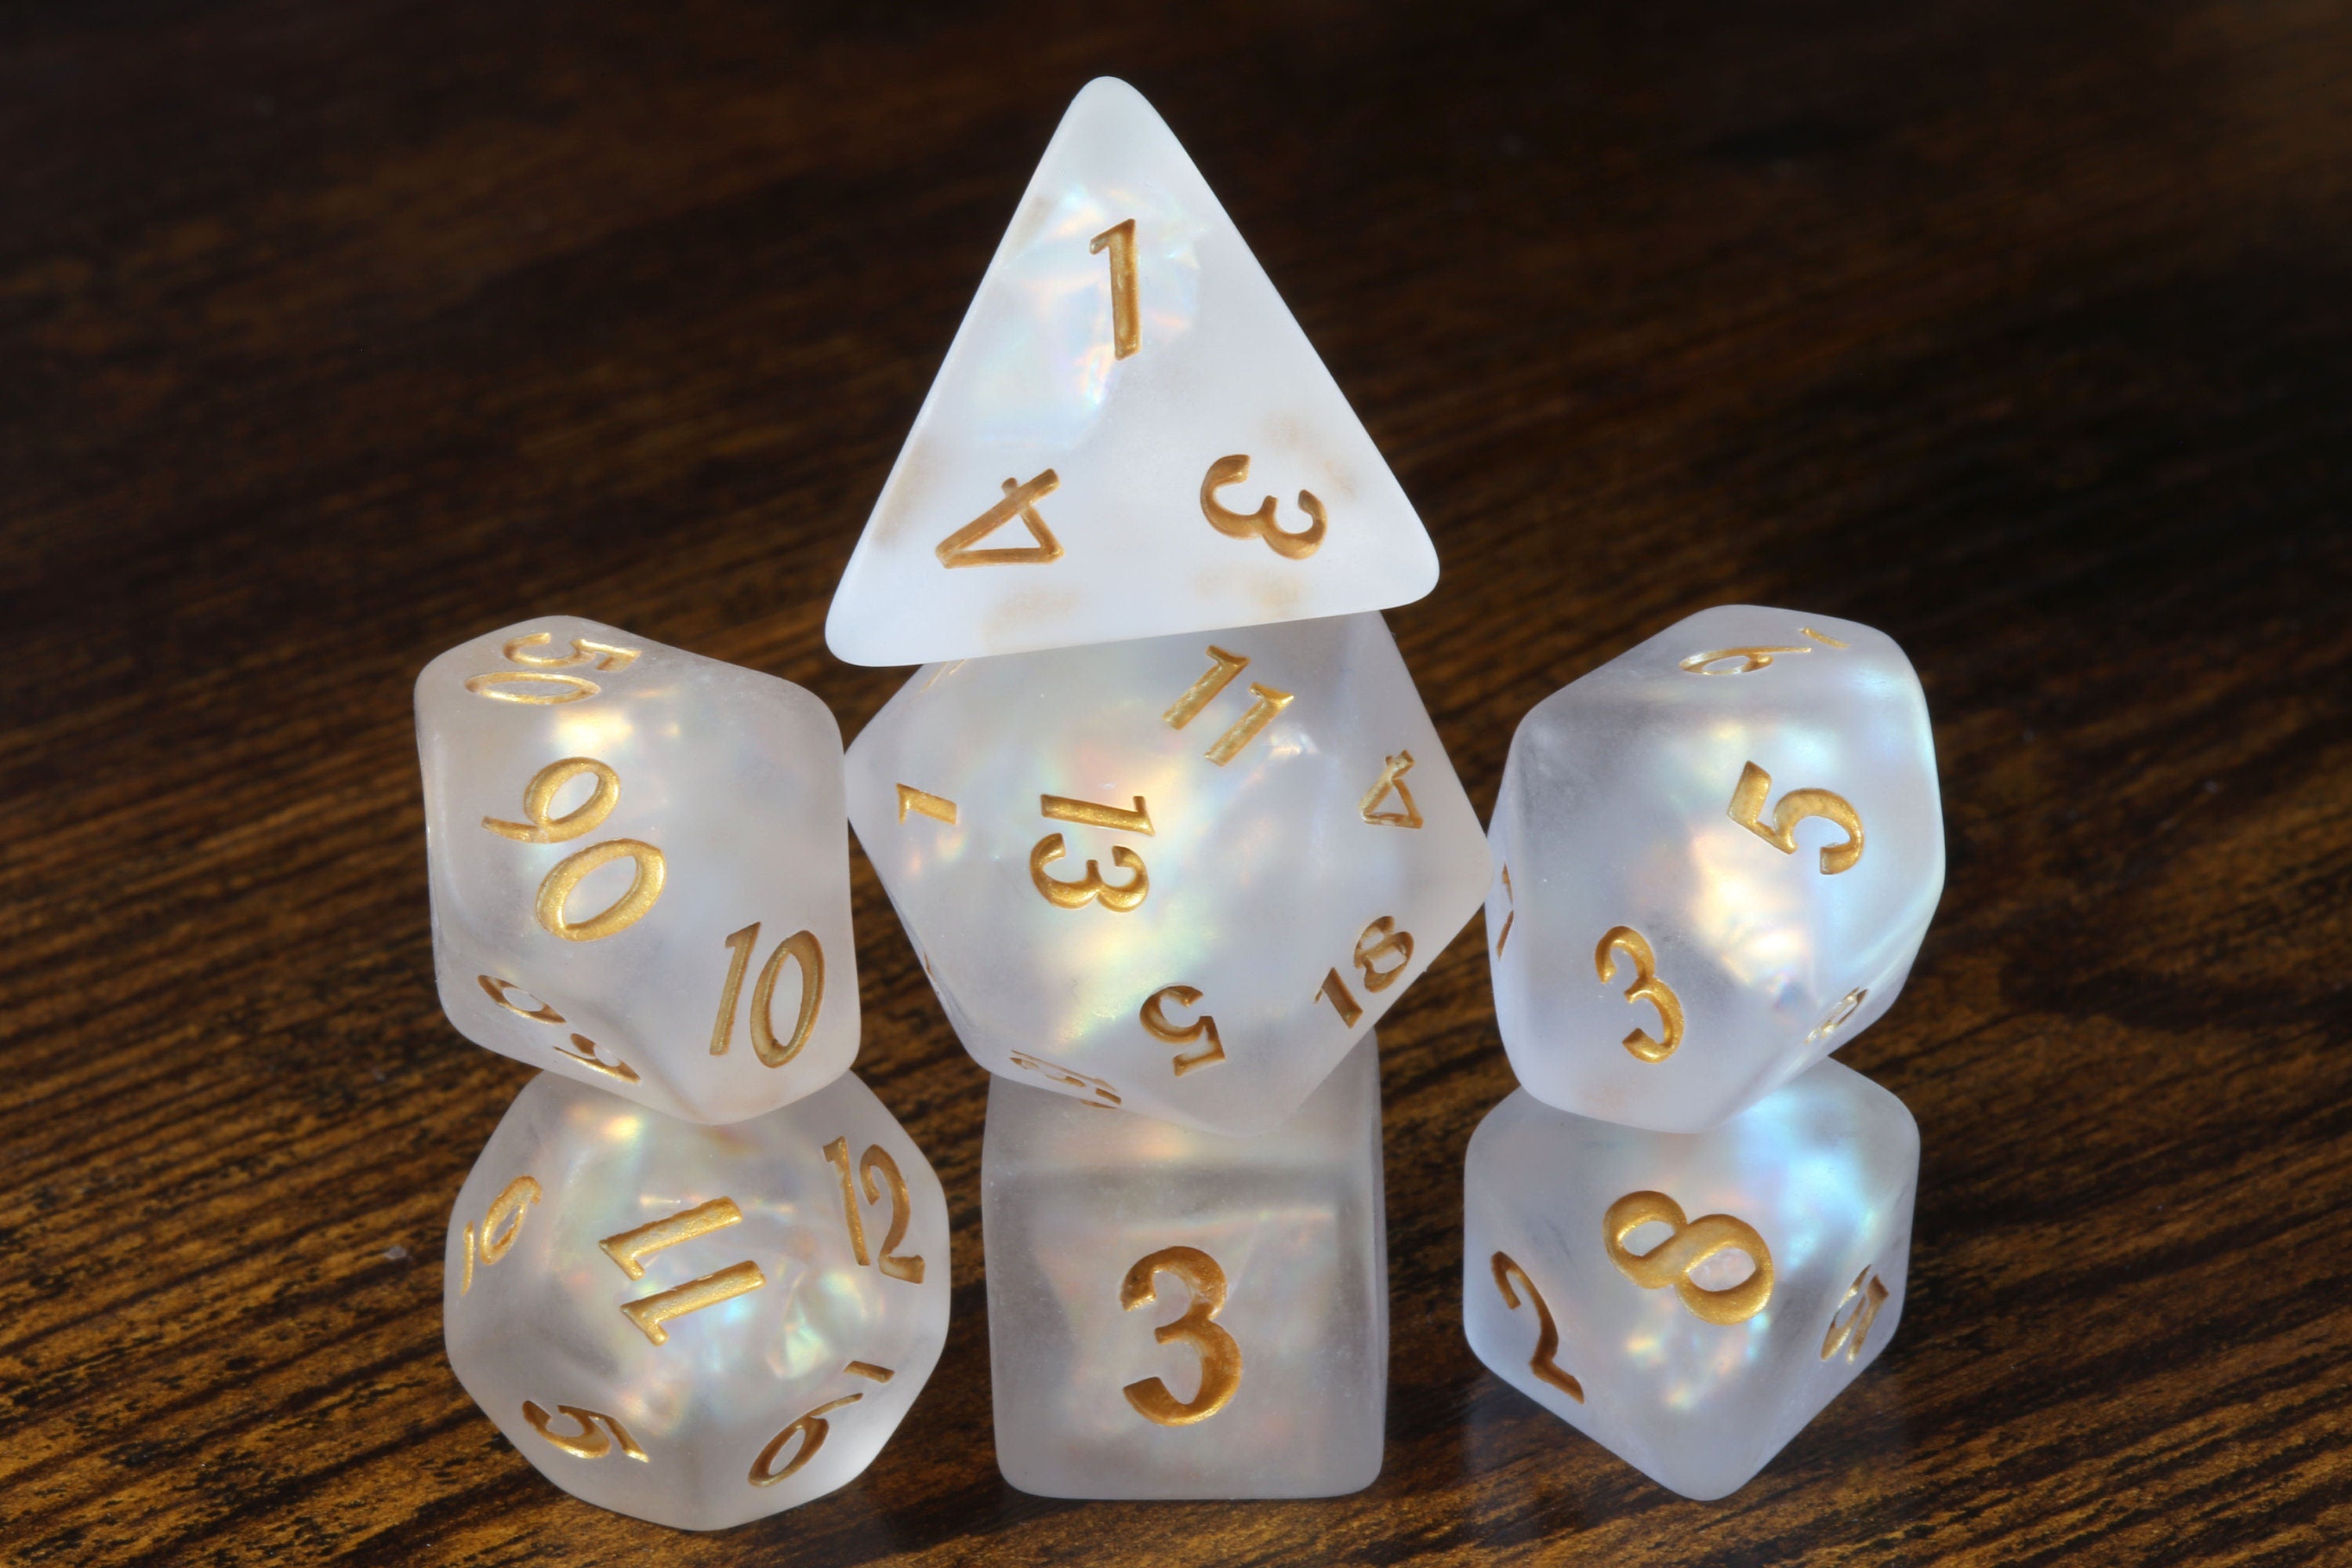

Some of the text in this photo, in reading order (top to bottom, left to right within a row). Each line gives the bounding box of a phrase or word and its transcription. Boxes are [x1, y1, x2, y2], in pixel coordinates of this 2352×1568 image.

[1090, 218, 1142, 361] 1
[935, 468, 1065, 569] 4
[1200, 454, 1328, 561] 3
[465, 632, 642, 704] 50
[1162, 644, 1294, 767] 11
[481, 757, 666, 942] 90
[1359, 749, 1423, 829] 4
[1727, 760, 1864, 875] 5
[1029, 793, 1156, 913] 13
[710, 921, 826, 1069] 10
[1138, 985, 1226, 1078] 5
[1314, 916, 1414, 1029] 18
[1594, 925, 1685, 1064] 3
[822, 1135, 925, 1284] 12
[1602, 1189, 1775, 1327] 8
[598, 1196, 768, 1347] 11
[1490, 1251, 1585, 1404] 2
[1119, 1245, 1243, 1428] 3
[522, 1400, 650, 1463] 5
